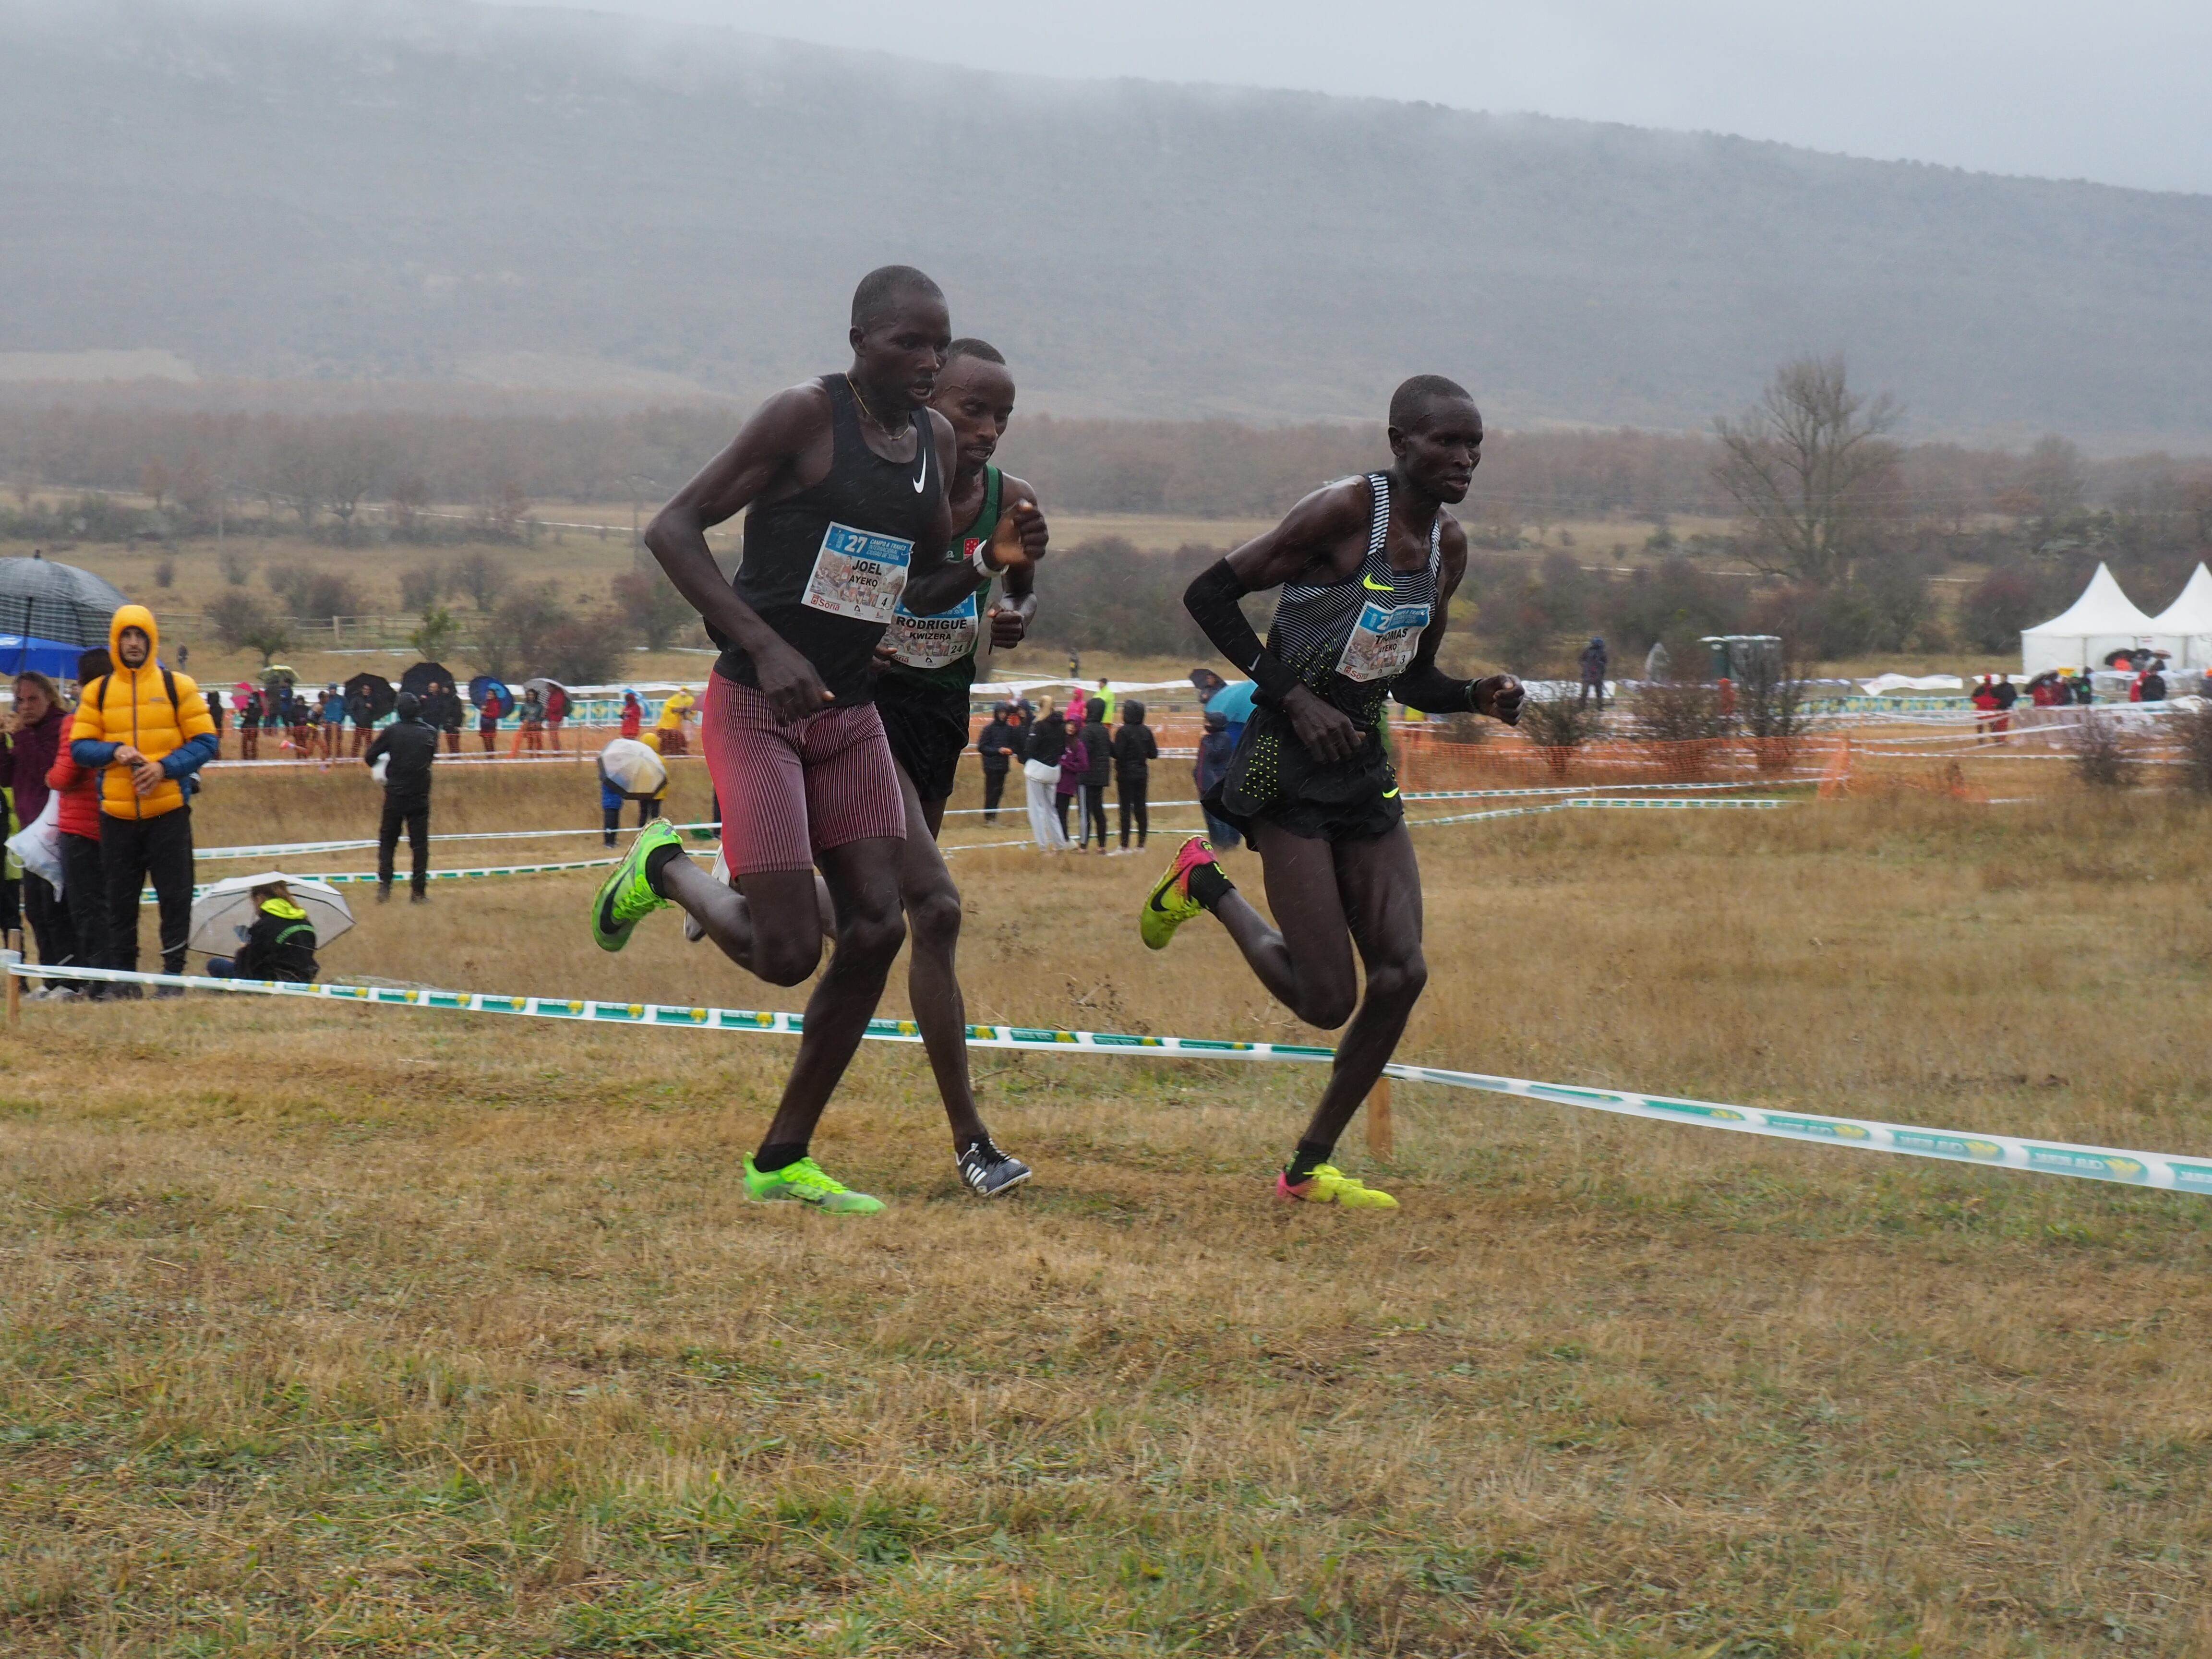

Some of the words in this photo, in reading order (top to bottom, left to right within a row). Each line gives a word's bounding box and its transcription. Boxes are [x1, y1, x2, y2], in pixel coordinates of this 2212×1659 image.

[844, 535, 868, 553] 27
[852, 560, 882, 576] JOEL
[849, 575, 878, 588] AYEKO
[818, 599, 840, 611] Soria
[881, 597, 888, 607] 4
[896, 616, 967, 630] RODRIGUE
[909, 632, 951, 640] KWIZERA
[950, 644, 963, 654] 24
[891, 655, 909, 663] oria
[1400, 655, 1406, 664] 3
